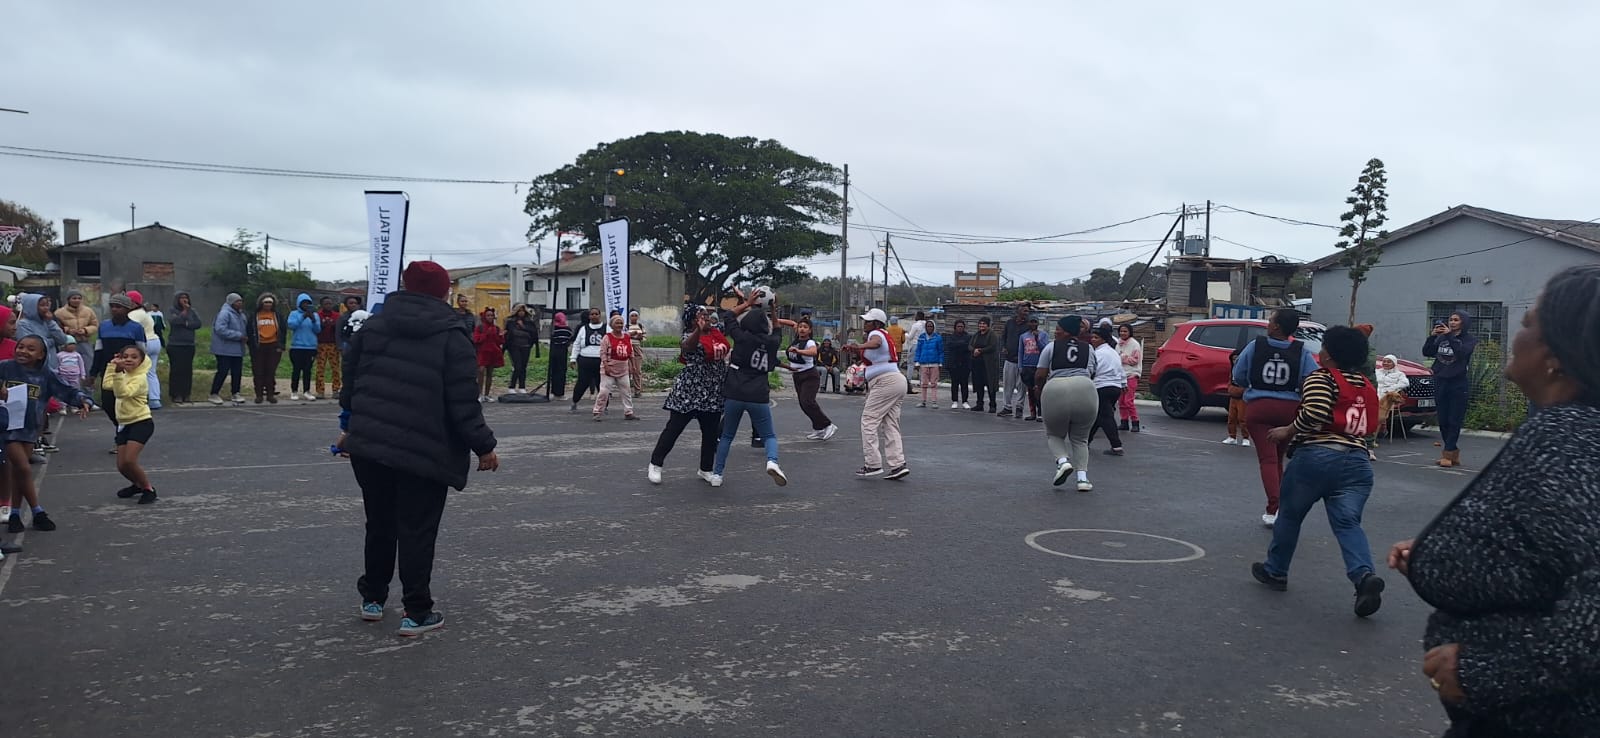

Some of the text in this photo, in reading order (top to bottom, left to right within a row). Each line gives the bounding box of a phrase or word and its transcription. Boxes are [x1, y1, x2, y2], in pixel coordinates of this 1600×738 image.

[589, 334, 602, 345] GS
[616, 345, 628, 357] GK
[1067, 346, 1079, 363] C
[750, 350, 769, 372] GA
[1262, 361, 1291, 386] GD
[1344, 406, 1368, 436] GA
